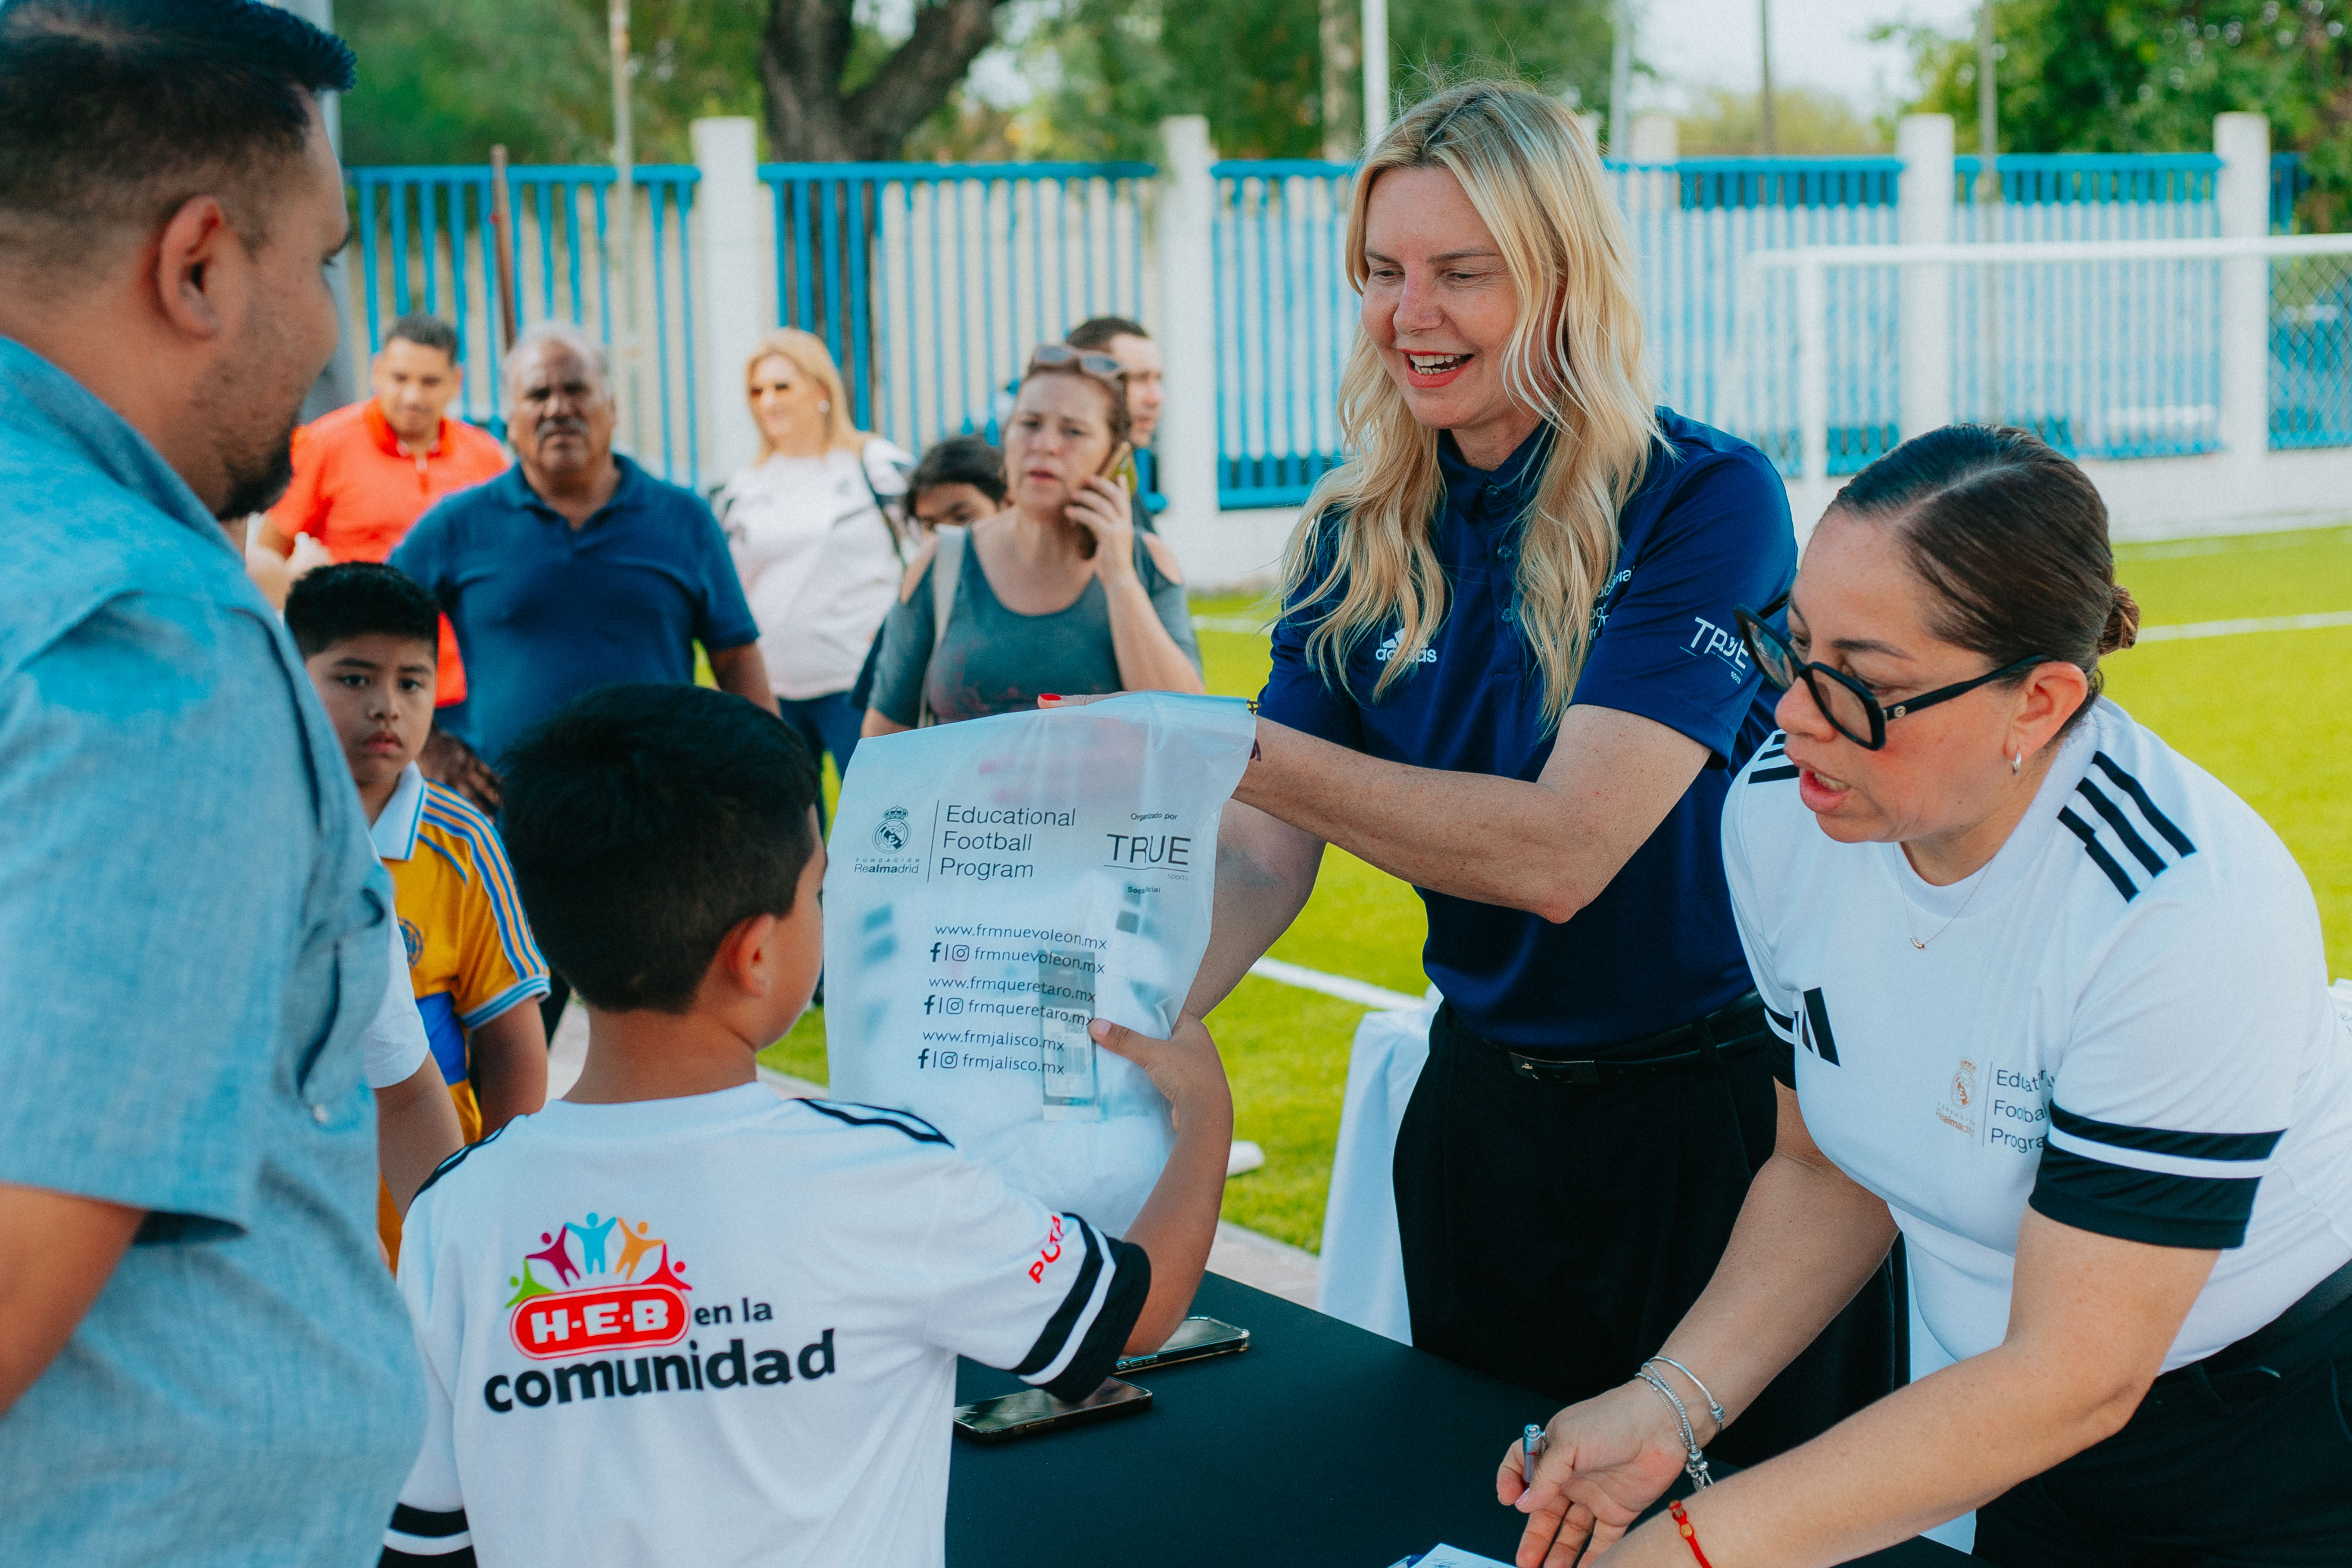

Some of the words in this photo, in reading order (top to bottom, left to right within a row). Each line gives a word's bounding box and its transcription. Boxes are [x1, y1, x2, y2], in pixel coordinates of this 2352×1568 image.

[946, 805, 1076, 826] Educational
[943, 830, 1032, 851] Football
[1107, 833, 1192, 866] TRUE
[940, 857, 1033, 881] Program
[935, 923, 1107, 950] www.frmnuevoleon.mx
[975, 947, 1105, 974] frmnuevoleon.mx
[929, 976, 1096, 1003] www.frmqueretaro.mx
[968, 1000, 1094, 1026] frmqueretaro.mx
[923, 1030, 1065, 1051] www.frmjalisco.mx
[963, 1054, 1065, 1075] frmjalisco.mx
[694, 1303, 732, 1325] en
[742, 1297, 773, 1322] la
[484, 1327, 837, 1413] comunidad
